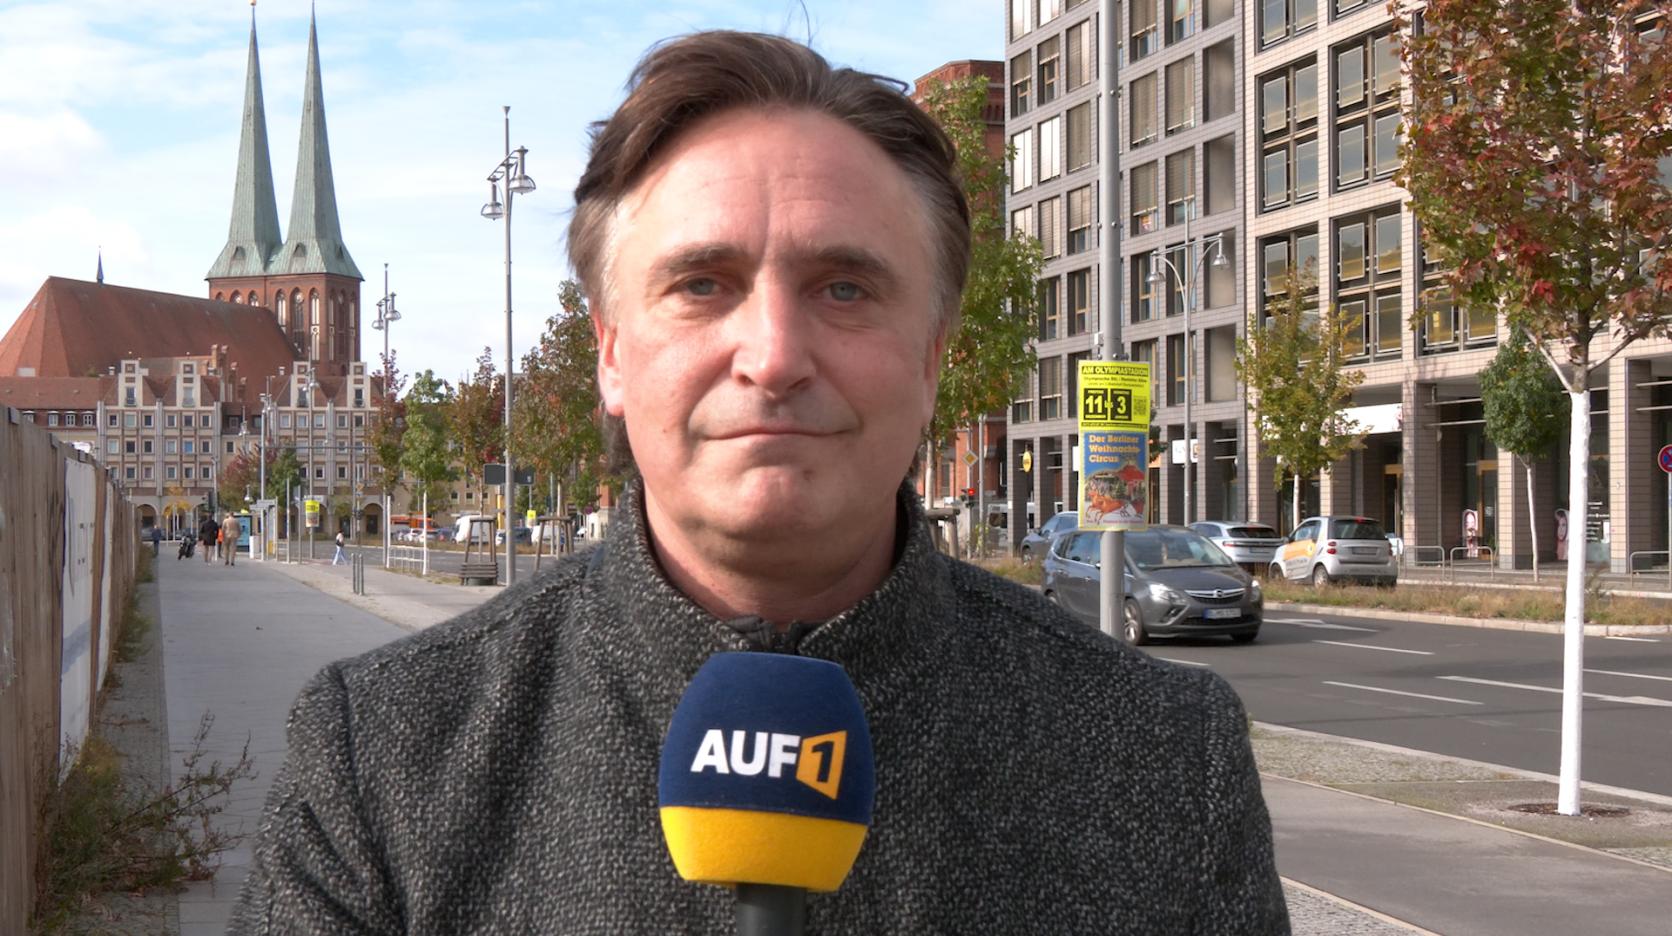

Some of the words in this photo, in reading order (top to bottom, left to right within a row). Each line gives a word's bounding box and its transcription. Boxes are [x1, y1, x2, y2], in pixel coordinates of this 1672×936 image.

[1083, 366, 1094, 374] AM
[1095, 366, 1148, 376] OLYMPIASTADION
[1085, 395, 1103, 413] 11
[1117, 396, 1126, 414] 3
[1088, 434, 1105, 442] Der
[1107, 435, 1139, 443] Berliner
[1088, 454, 1120, 463] Circus
